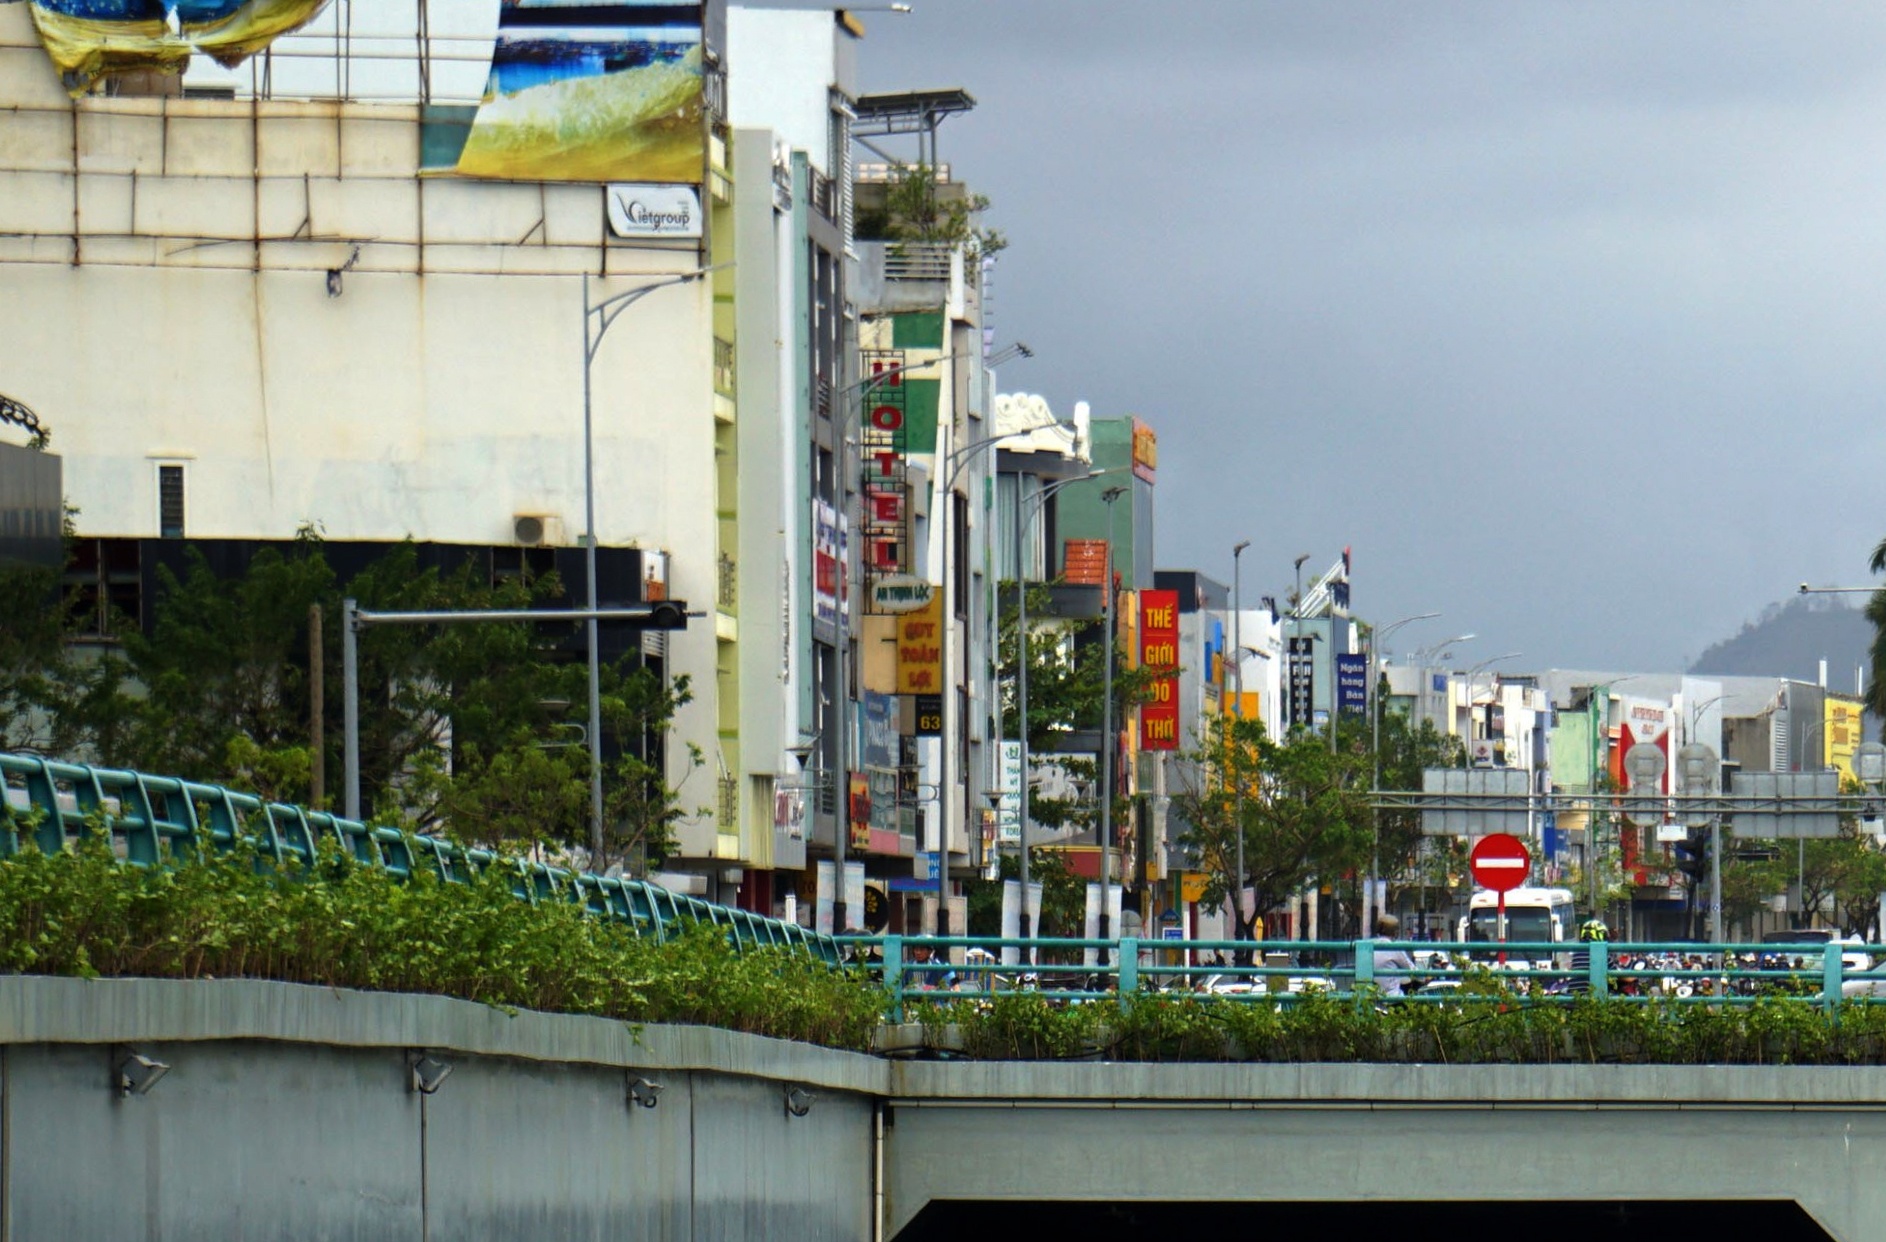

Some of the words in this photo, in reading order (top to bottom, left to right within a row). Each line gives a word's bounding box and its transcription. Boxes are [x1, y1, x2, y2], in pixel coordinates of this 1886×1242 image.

[871, 361, 904, 568] HOTEL
[1146, 604, 1173, 628] THẾ
[1145, 641, 1174, 665] GIỚI
[920, 715, 941, 731] 63
[1146, 714, 1174, 739] THỜ
